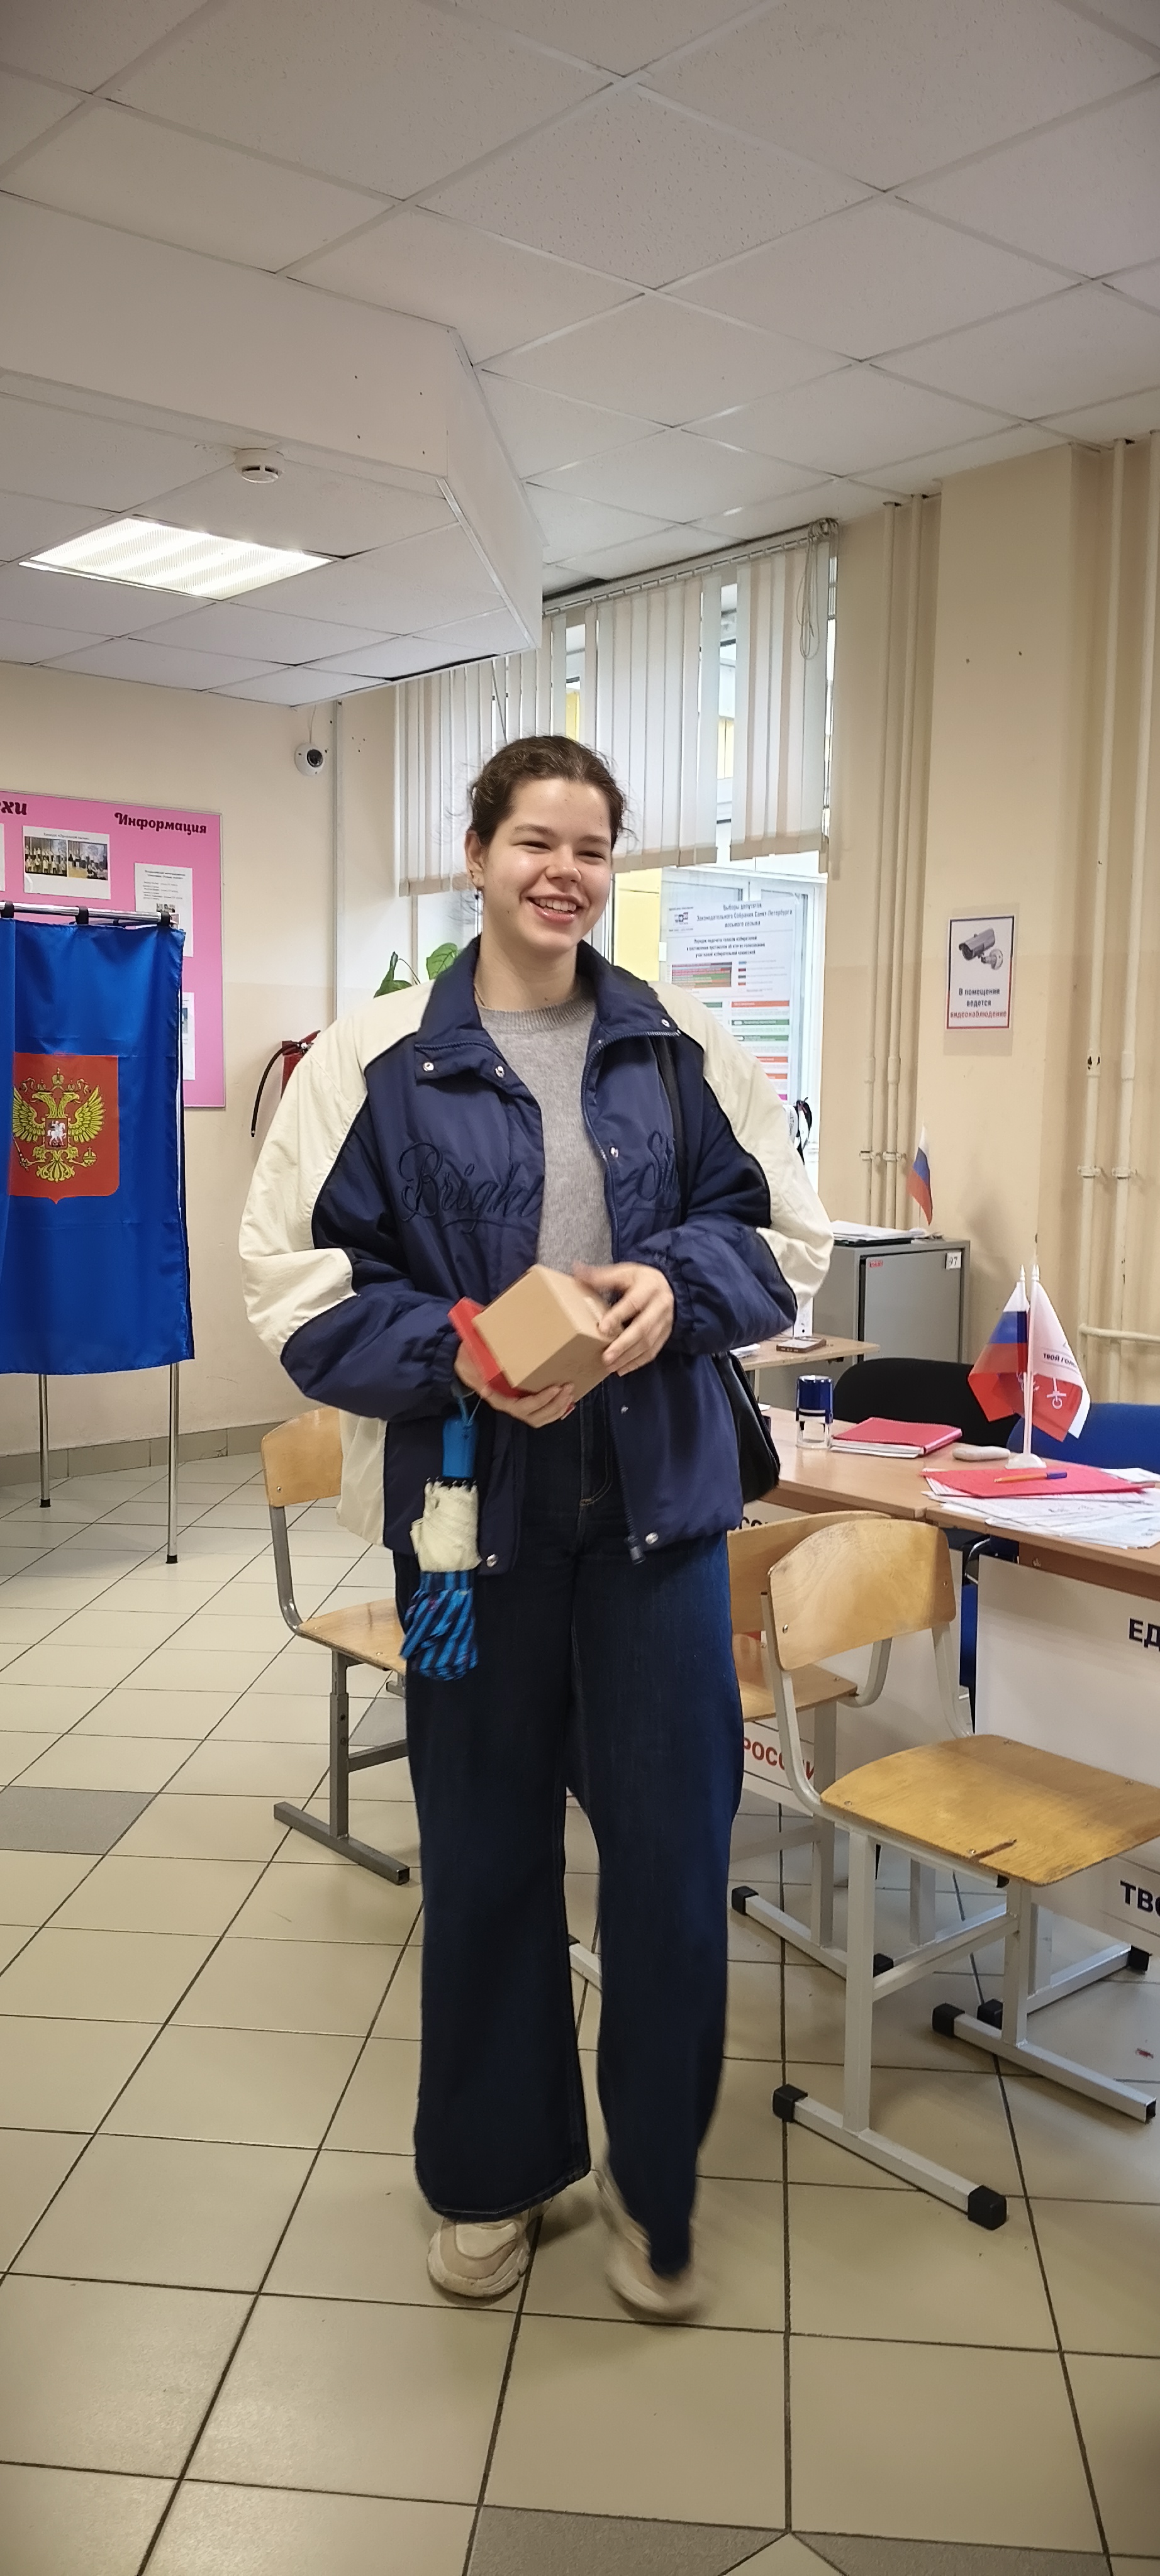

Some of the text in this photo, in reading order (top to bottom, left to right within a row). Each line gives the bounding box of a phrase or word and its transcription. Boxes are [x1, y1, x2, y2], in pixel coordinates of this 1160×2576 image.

[0, 801, 27, 816] хи
[114, 812, 207, 835] Информация
[1043, 1352, 1060, 1362] ТВОЙ
